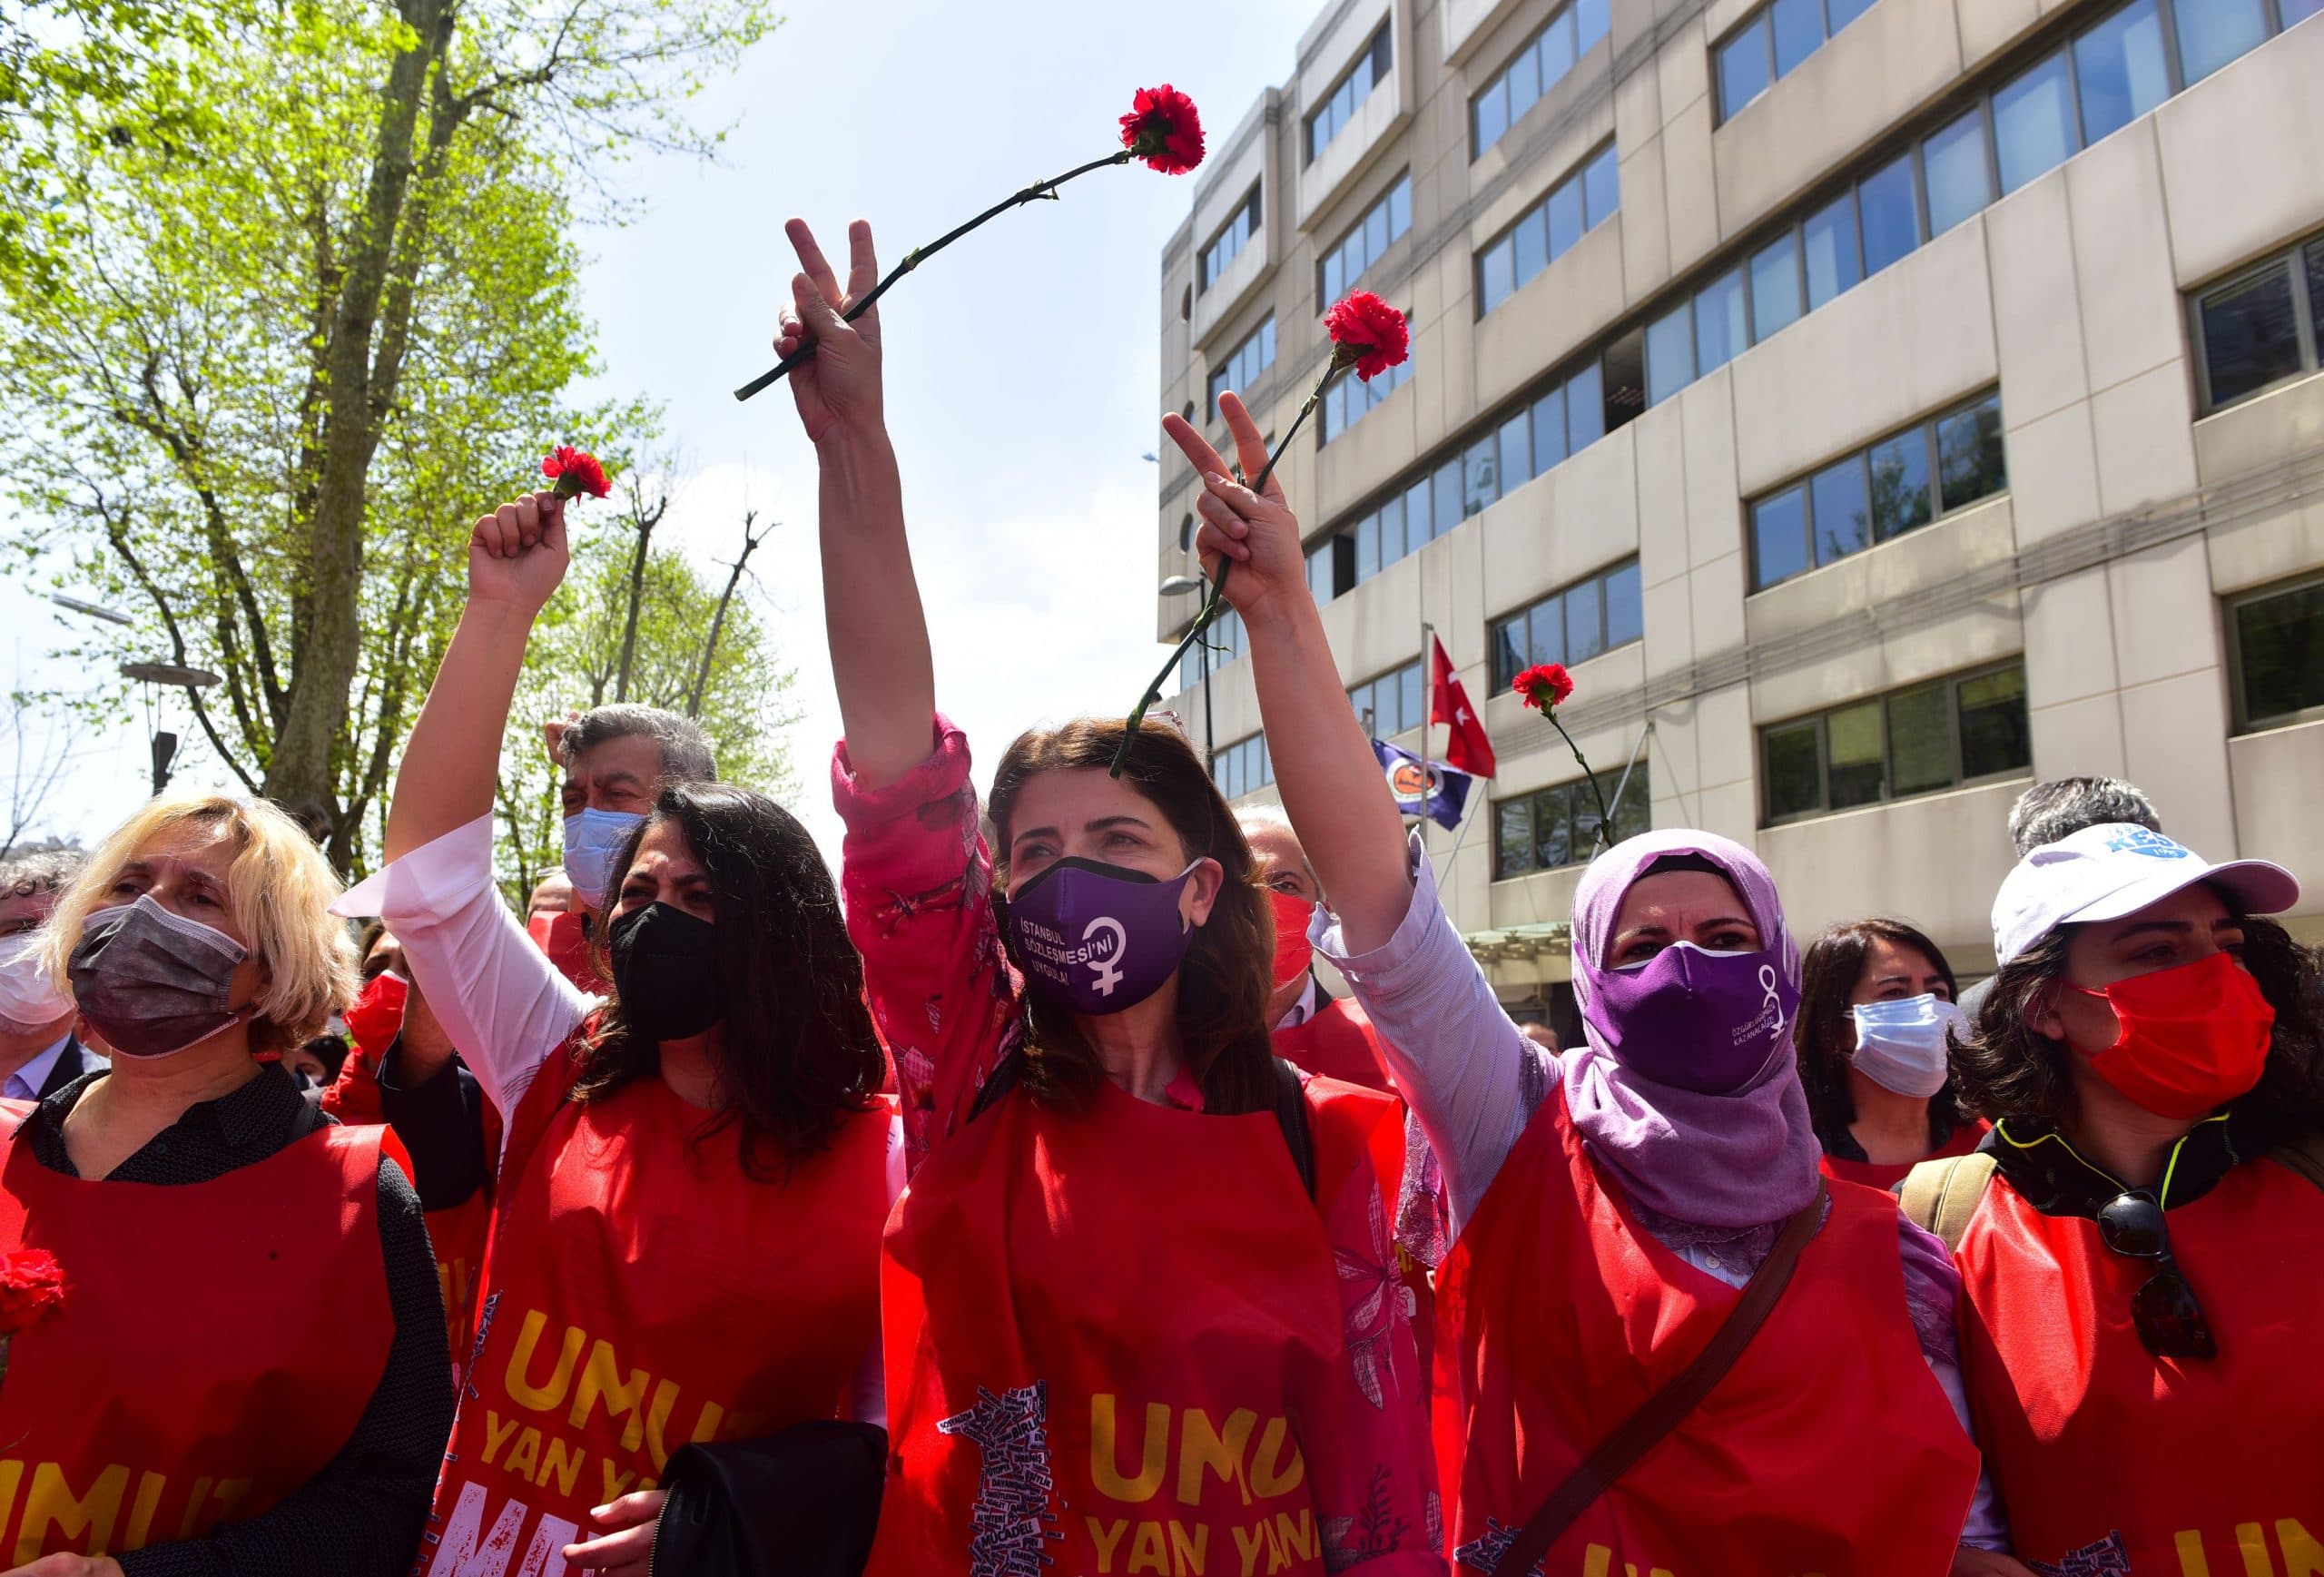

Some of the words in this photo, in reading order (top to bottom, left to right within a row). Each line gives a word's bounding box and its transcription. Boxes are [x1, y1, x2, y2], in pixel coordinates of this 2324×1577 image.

[1019, 916, 1066, 946] İSTANBUL
[504, 1307, 763, 1475] UMU
[479, 1408, 586, 1498] YAN
[1084, 1513, 1209, 1577] YAN
